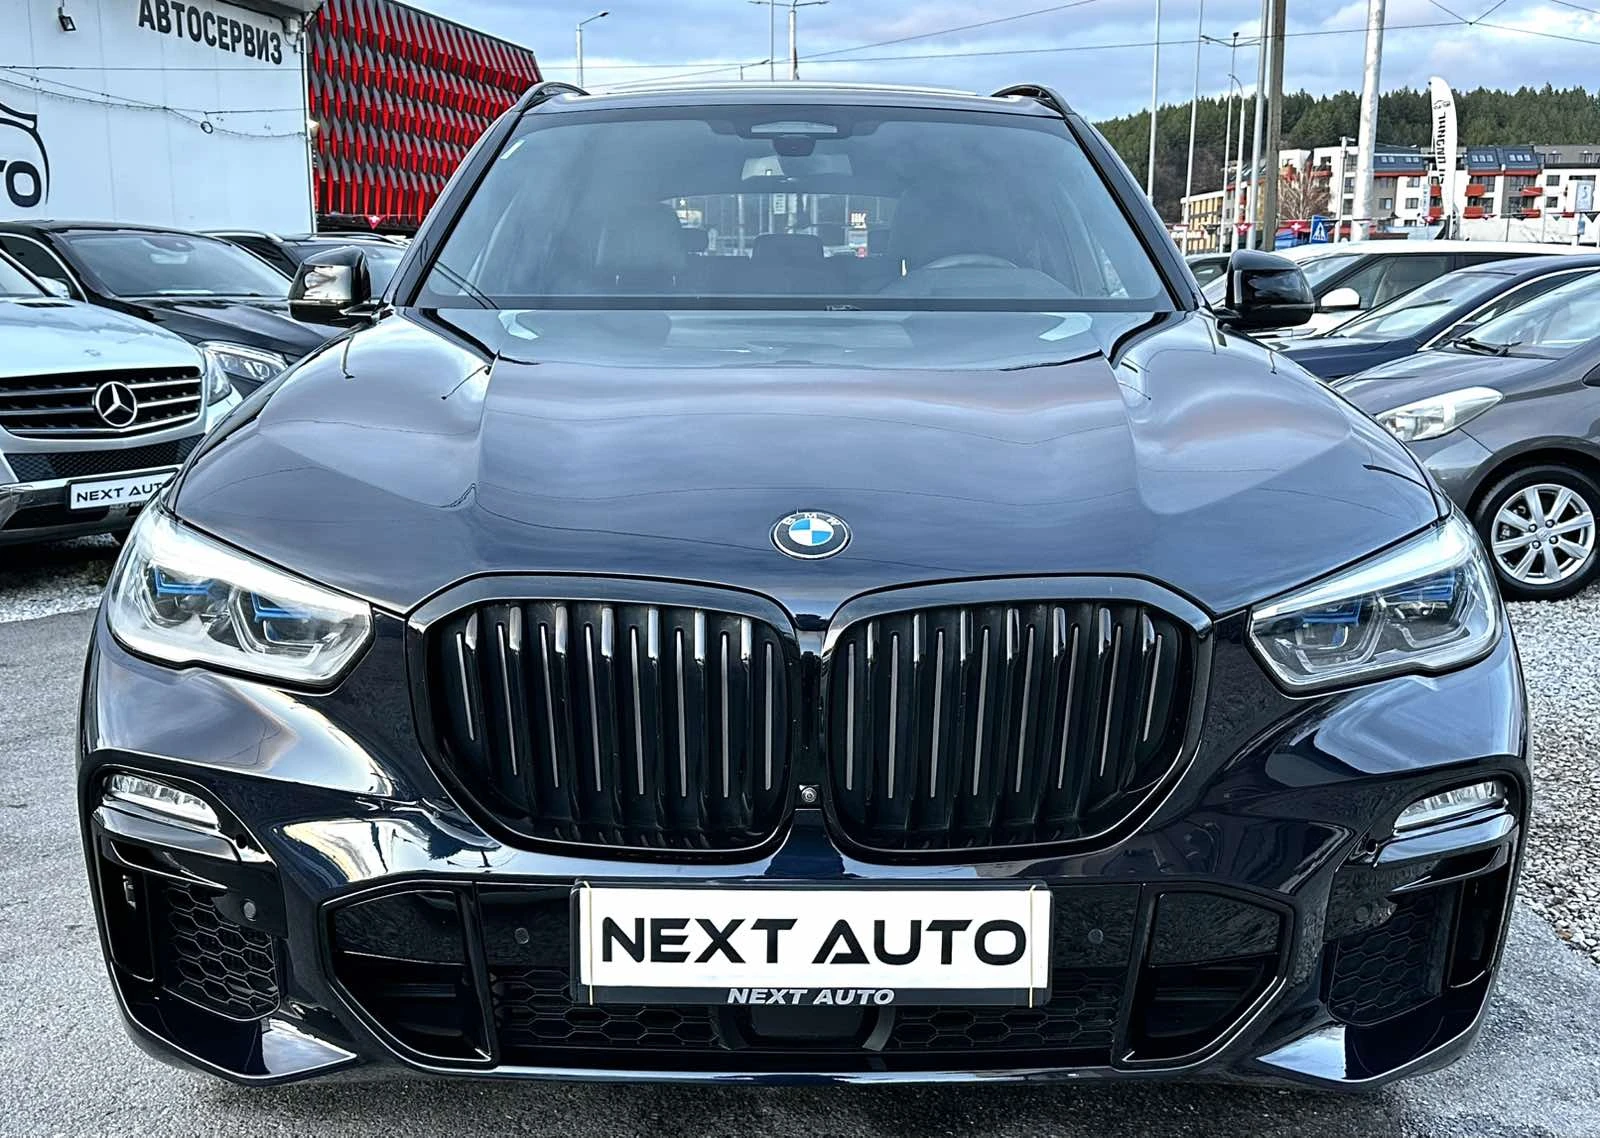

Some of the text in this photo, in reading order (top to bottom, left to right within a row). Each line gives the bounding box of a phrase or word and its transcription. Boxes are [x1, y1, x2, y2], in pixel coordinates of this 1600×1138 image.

[138, 0, 282, 65] АВТОСЕРВИЗ
[76, 482, 162, 502] NEXT AUT
[602, 916, 1027, 966] NEXT AUTO
[727, 988, 895, 1005] NEXT AUTO
